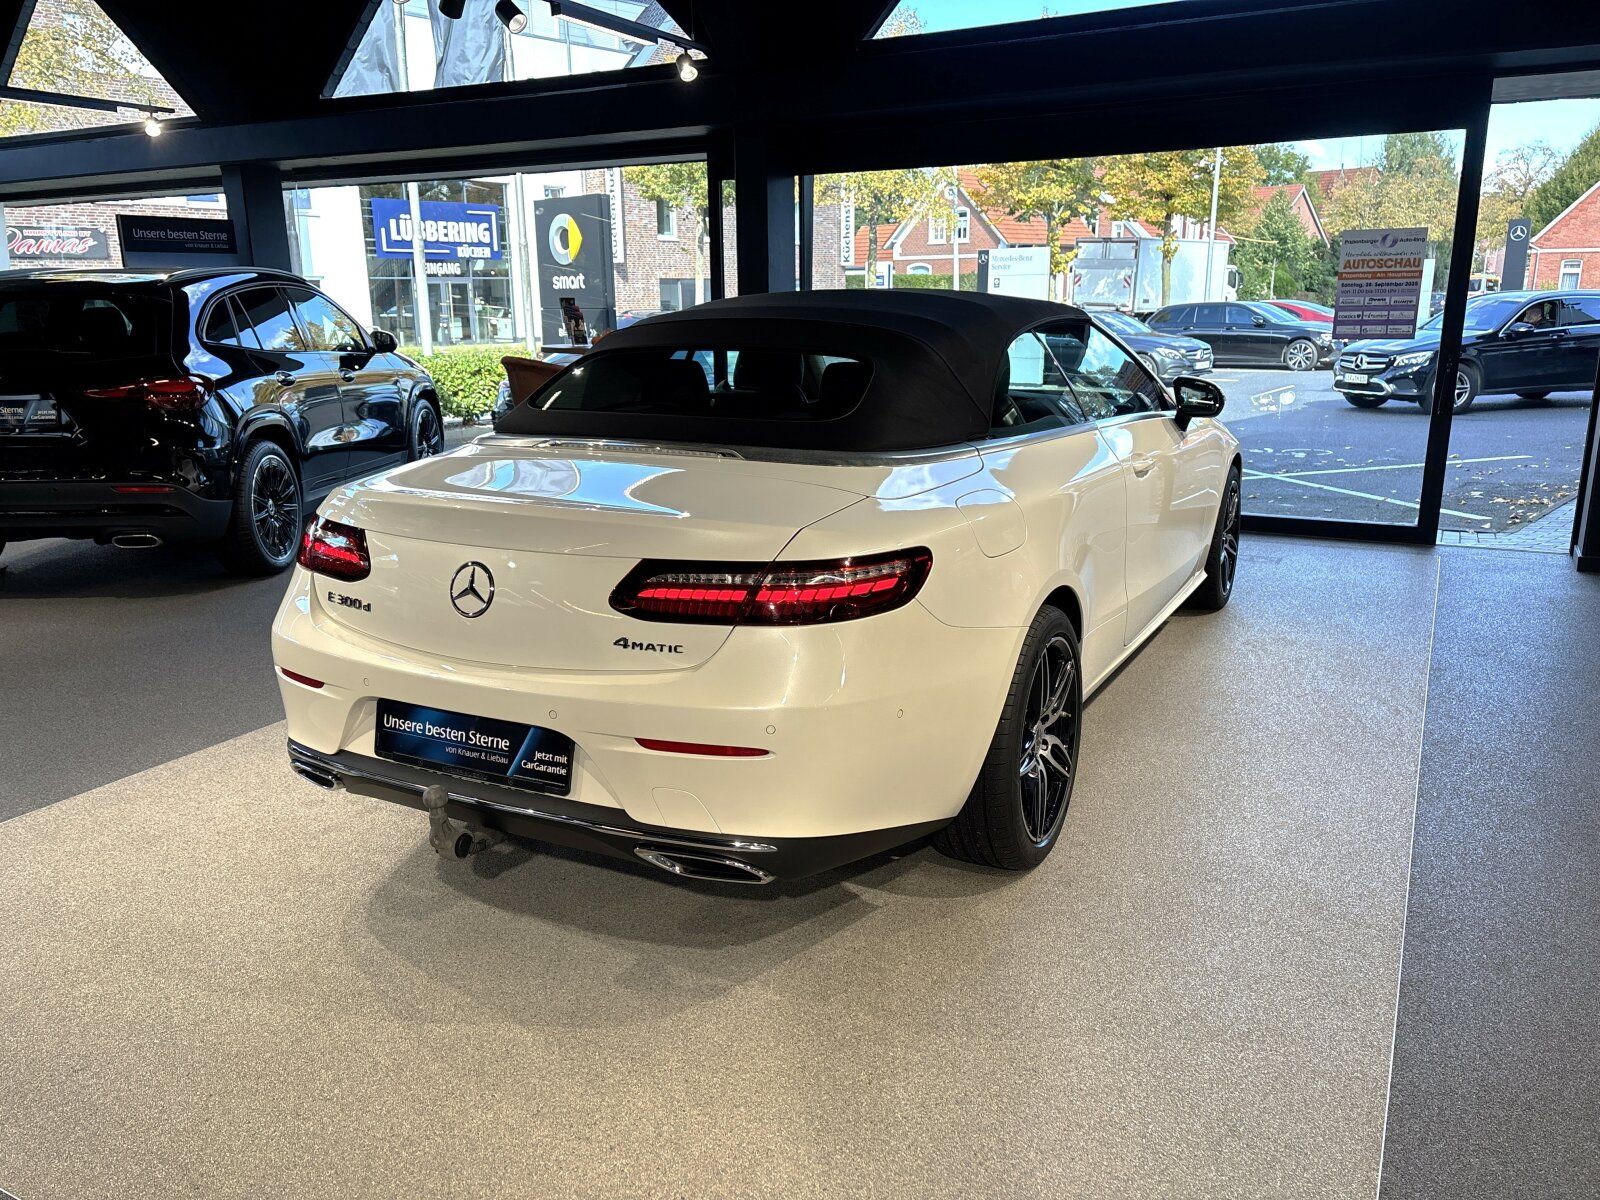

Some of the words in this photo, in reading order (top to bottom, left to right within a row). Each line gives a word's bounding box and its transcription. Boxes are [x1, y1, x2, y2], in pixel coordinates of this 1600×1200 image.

[133, 228, 166, 239] Unsere
[167, 229, 199, 240] besten
[200, 230, 228, 241] Sterne
[457, 244, 492, 258] KÜCHEN
[1343, 257, 1422, 270] AUTOSCHAU
[552, 273, 585, 289] smart
[327, 591, 336, 604] E
[613, 636, 684, 653] 4MATIC
[383, 713, 423, 733] Unsere
[425, 721, 466, 743] besten
[468, 730, 510, 750] Sterne
[445, 746, 457, 754] von
[457, 747, 480, 759] Knauer
[480, 752, 486, 760] &
[486, 753, 509, 764] Liebau
[533, 750, 553, 762] Jetzt
[553, 753, 568, 764] mit
[521, 760, 567, 776] CarGarantie
